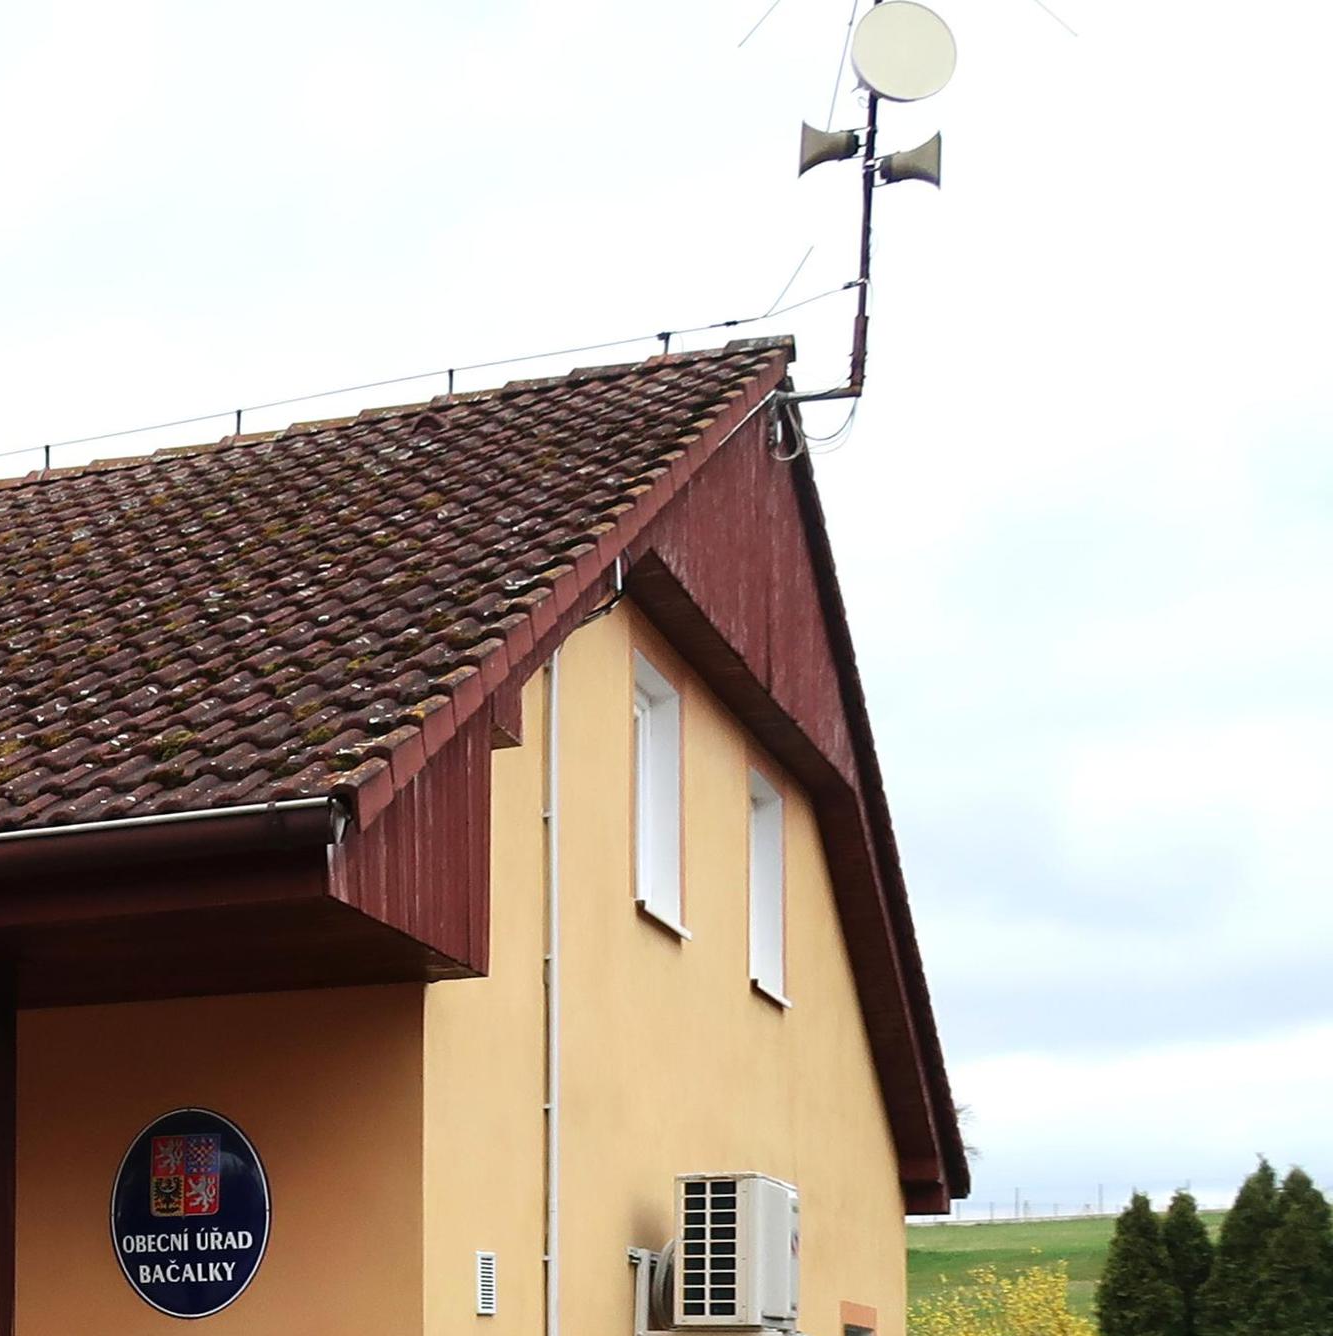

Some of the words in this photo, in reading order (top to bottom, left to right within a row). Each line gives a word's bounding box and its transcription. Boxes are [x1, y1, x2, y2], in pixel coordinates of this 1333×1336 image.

[122, 1228, 189, 1253] OBECNÍ
[196, 1227, 253, 1251] ÚŘAD
[139, 1259, 236, 1283] BAČALKY
